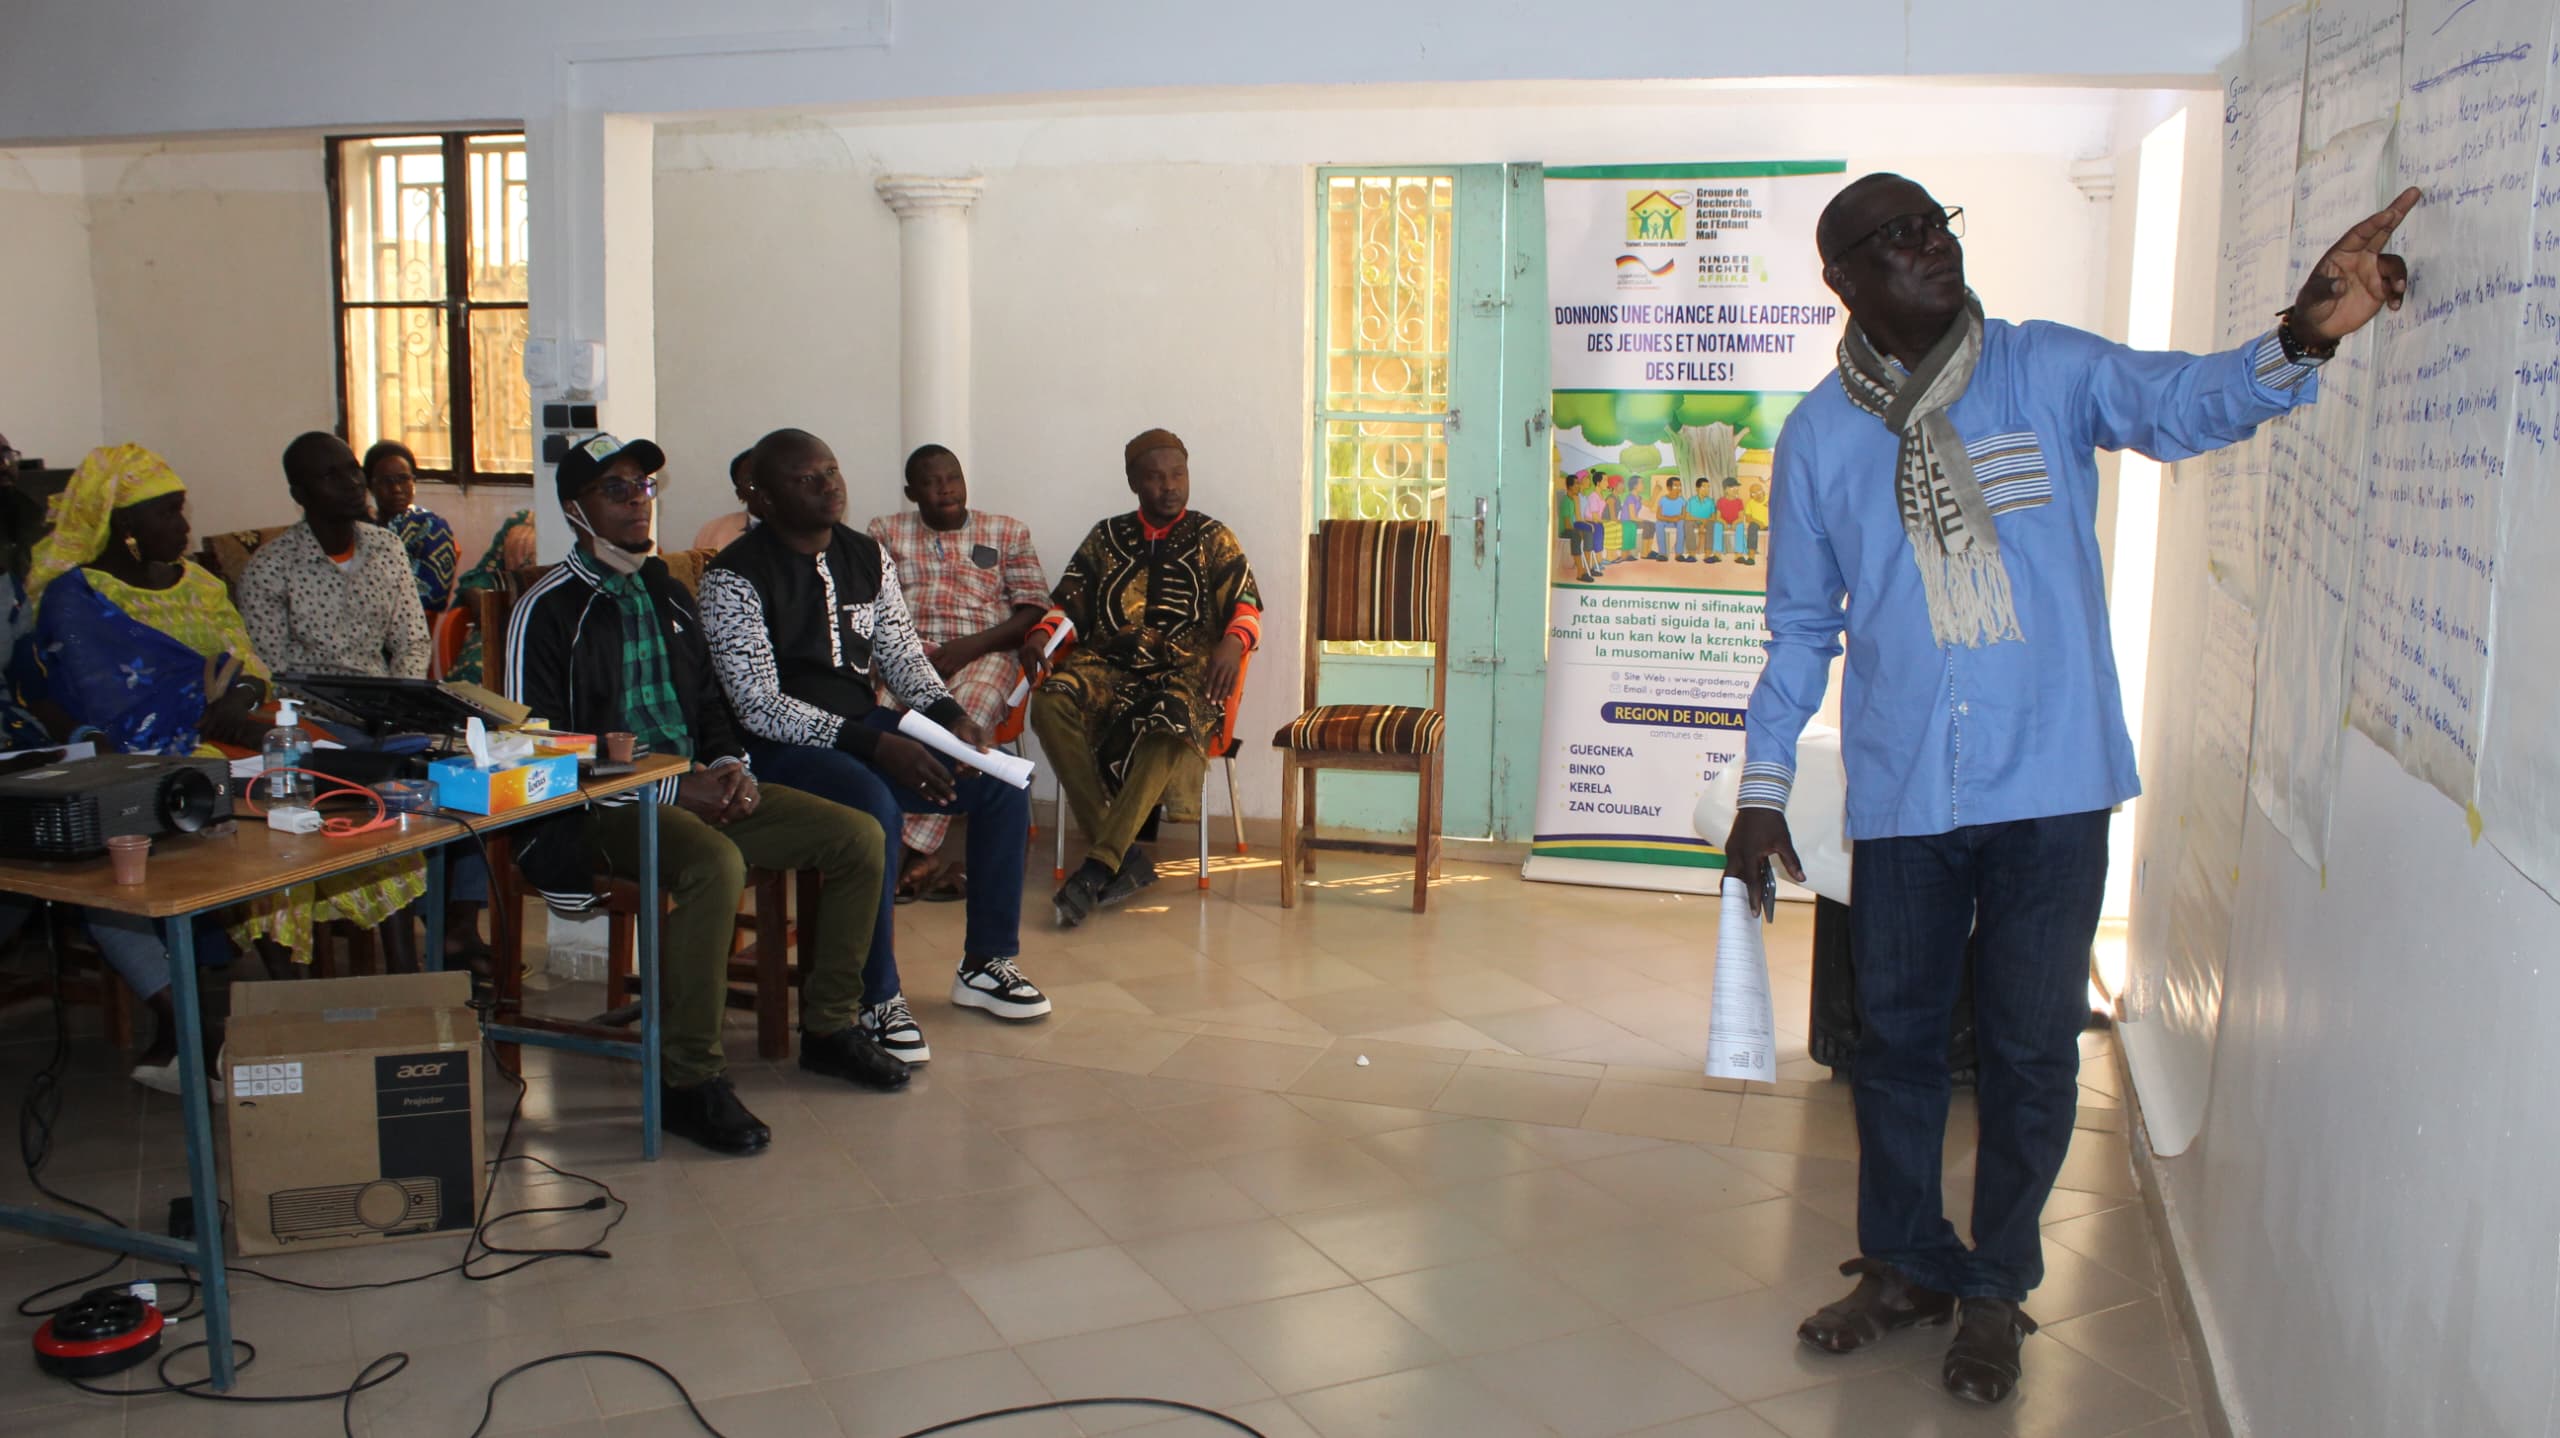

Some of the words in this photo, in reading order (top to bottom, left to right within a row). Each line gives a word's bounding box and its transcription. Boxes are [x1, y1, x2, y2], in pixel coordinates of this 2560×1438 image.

[1696, 188, 1733, 199] Groupe
[1735, 187, 1749, 197] de
[1696, 208, 1729, 219] Action
[1730, 208, 1762, 219] Droits
[1696, 219, 1709, 229] de
[1696, 230, 1717, 240] Mali
[1698, 255, 1749, 264] KINDER
[1698, 264, 1749, 273] RECHTE
[1698, 274, 1748, 283] AFRIKA
[1555, 304, 1618, 324] DONNONS
[1621, 304, 1650, 324] UNE
[1654, 304, 1714, 324] CHANCE
[1717, 304, 1737, 324] AU
[1740, 305, 1836, 325] LEADERSHIP
[1587, 333, 1613, 352] DES
[1616, 333, 1673, 352] JEUNES
[1675, 333, 1694, 352] ET
[1697, 334, 1796, 353] NOTAMMENT
[1645, 362, 1674, 381] DES
[1580, 595, 1597, 607] Ka
[1685, 599, 1697, 611] ni
[1701, 599, 1765, 614] sifinakaw
[1615, 614, 1656, 625] sabati
[1661, 615, 1710, 630] siguida
[1714, 617, 1729, 631] la,
[1735, 619, 1755, 630] ani
[1587, 631, 1595, 640] u
[1600, 628, 1625, 641] kun
[1629, 630, 1653, 642] kan
[1658, 631, 1686, 644] kow
[1691, 633, 1702, 645] la
[1596, 644, 1607, 657] la
[1611, 648, 1695, 661] musomaniw
[1700, 650, 1728, 663] Mali
[1624, 671, 1641, 681] Site
[1644, 673, 1665, 682] Web
[1623, 684, 1647, 694] Email
[1615, 706, 1669, 722] REGION
[1673, 709, 1691, 723] DE
[1694, 710, 1744, 727] DIOILA
[1650, 730, 1691, 740] communes
[1693, 731, 1704, 740] de
[1570, 744, 1634, 757] GUEGNEKA
[1569, 763, 1606, 775] BINKO
[1569, 782, 1612, 794] KERELA
[1569, 801, 1594, 812] ZAN
[1597, 802, 1662, 817] COULIBALY
[396, 1062, 449, 1079] acer
[403, 1095, 445, 1107] Projector
